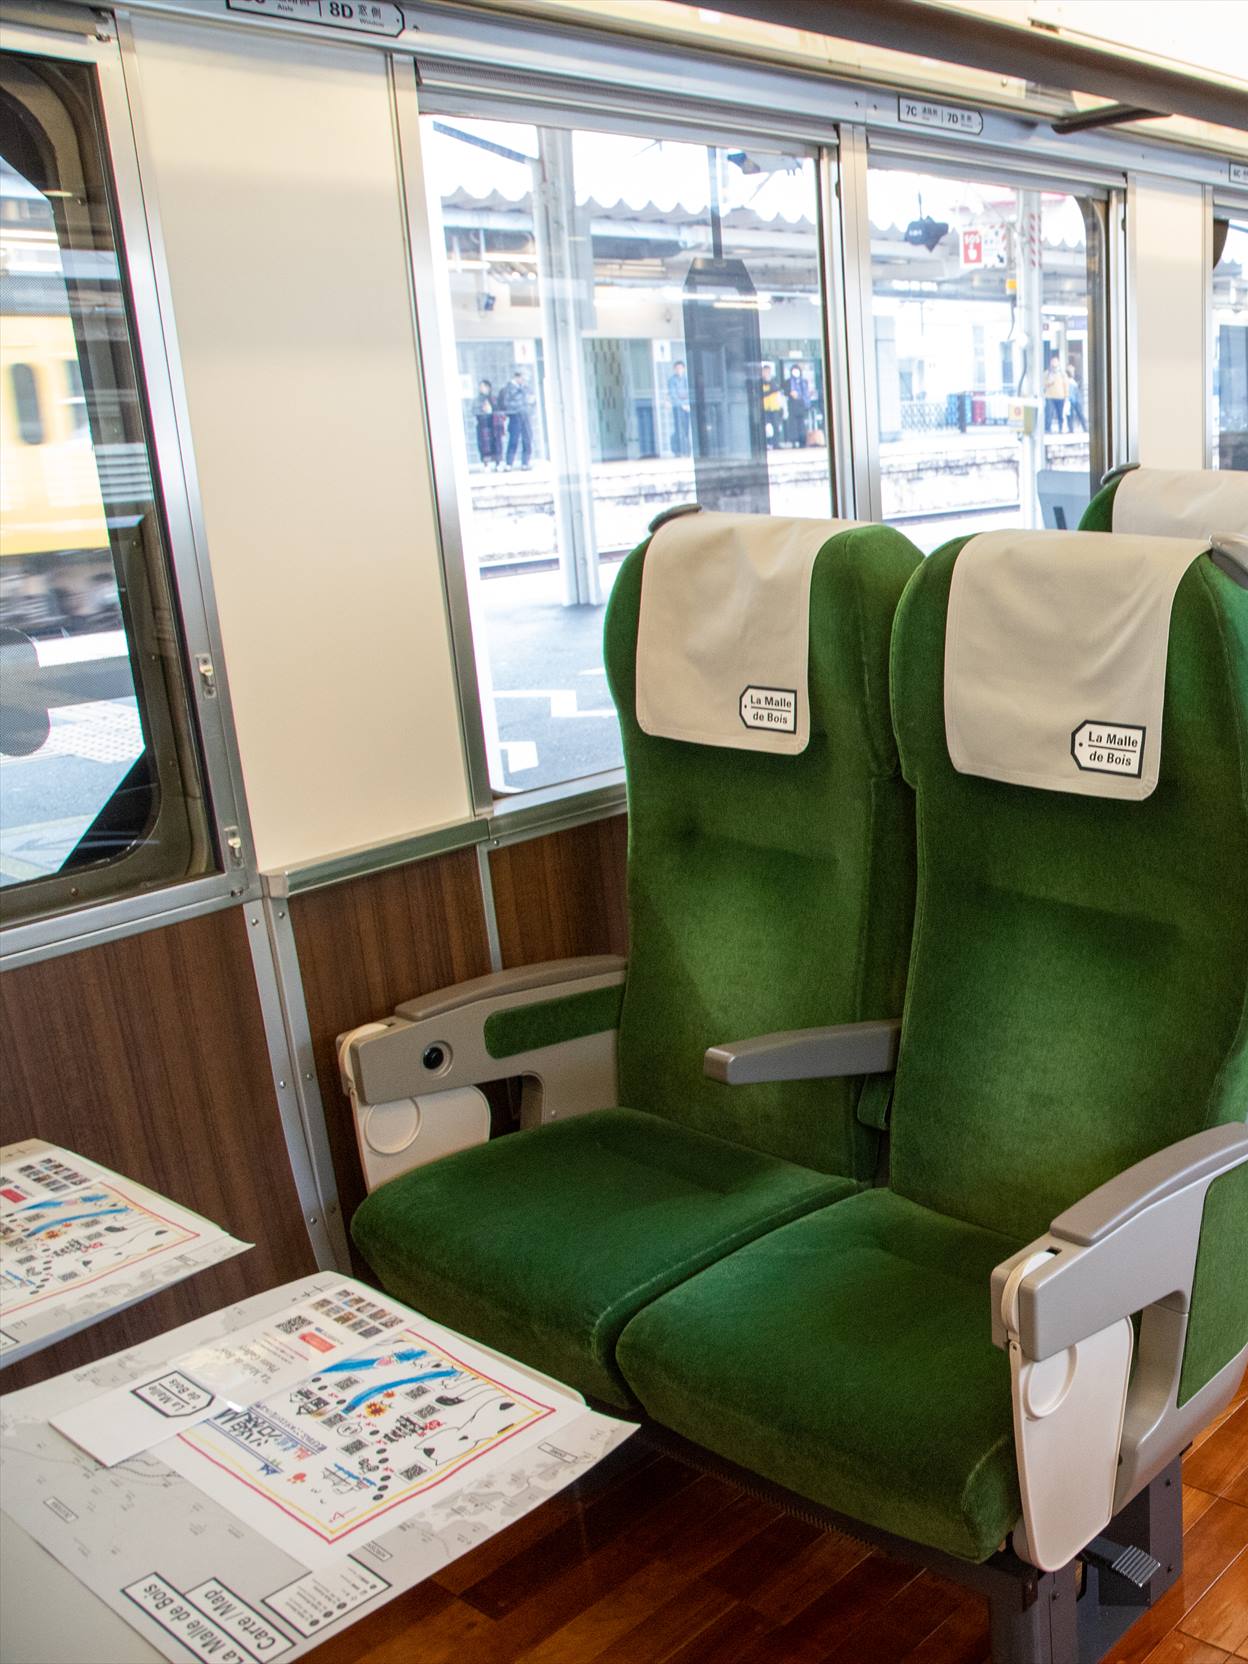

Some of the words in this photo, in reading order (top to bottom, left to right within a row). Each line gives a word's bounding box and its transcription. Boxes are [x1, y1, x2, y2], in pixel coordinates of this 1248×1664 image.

[329, 2, 353, 19] 8D
[905, 105, 917, 117] 7C
[947, 113, 959, 124] 7D
[750, 694, 761, 705] La
[764, 696, 792, 708] Malle
[753, 711, 764, 721] de
[767, 712, 788, 724] Bois
[1088, 731, 1103, 743] La
[1106, 733, 1138, 748] Malle
[1089, 750, 1103, 762] de
[1106, 752, 1131, 766] Bois
[143, 1583, 174, 1611] Bois
[204, 1589, 237, 1617] Map
[169, 1605, 191, 1622] de
[187, 1619, 226, 1654] Malle
[238, 1616, 276, 1650] Carte
